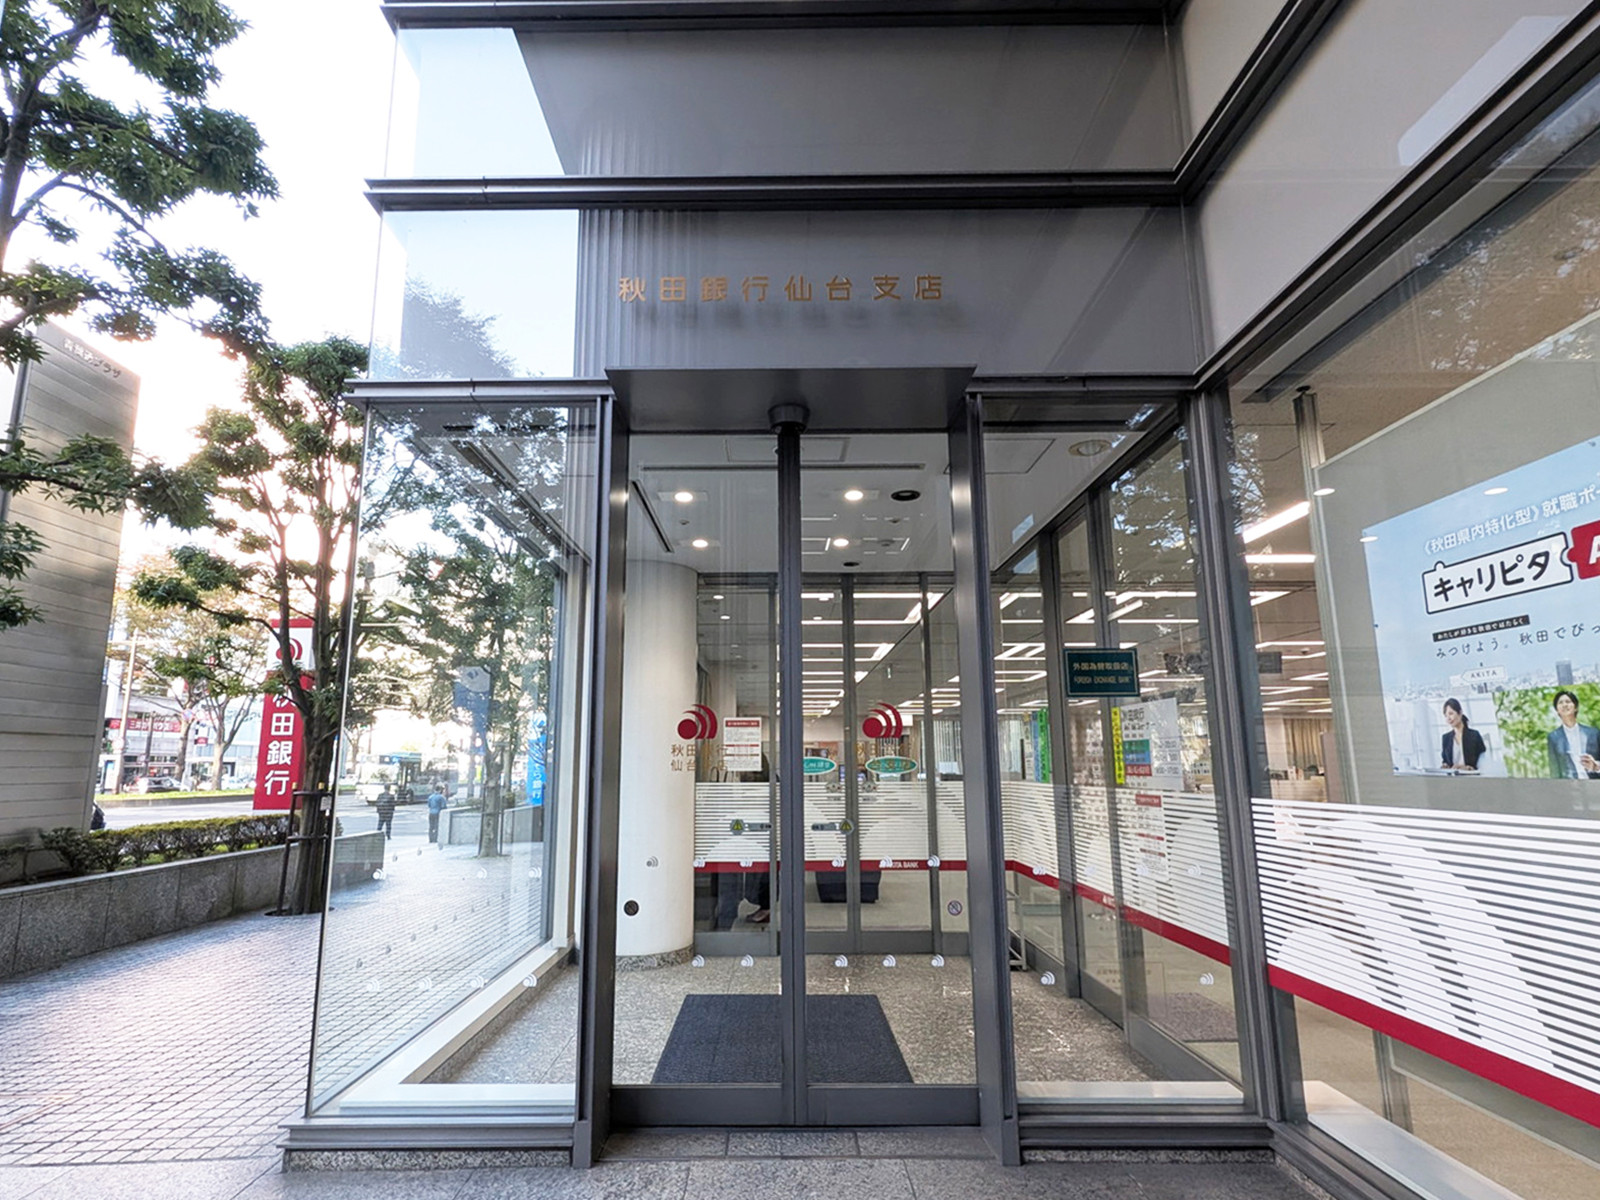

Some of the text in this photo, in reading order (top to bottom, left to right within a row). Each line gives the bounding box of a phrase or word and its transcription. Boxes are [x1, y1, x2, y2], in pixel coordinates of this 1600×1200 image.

[618, 275, 943, 303] 秋田銀行仙台支店
[1424, 485, 1600, 555] 《秋田県内特化型》就職ポ
[1433, 549, 1551, 603] キャリピタ
[1470, 670, 1498, 679] AKITA
[903, 861, 919, 869] BANK
